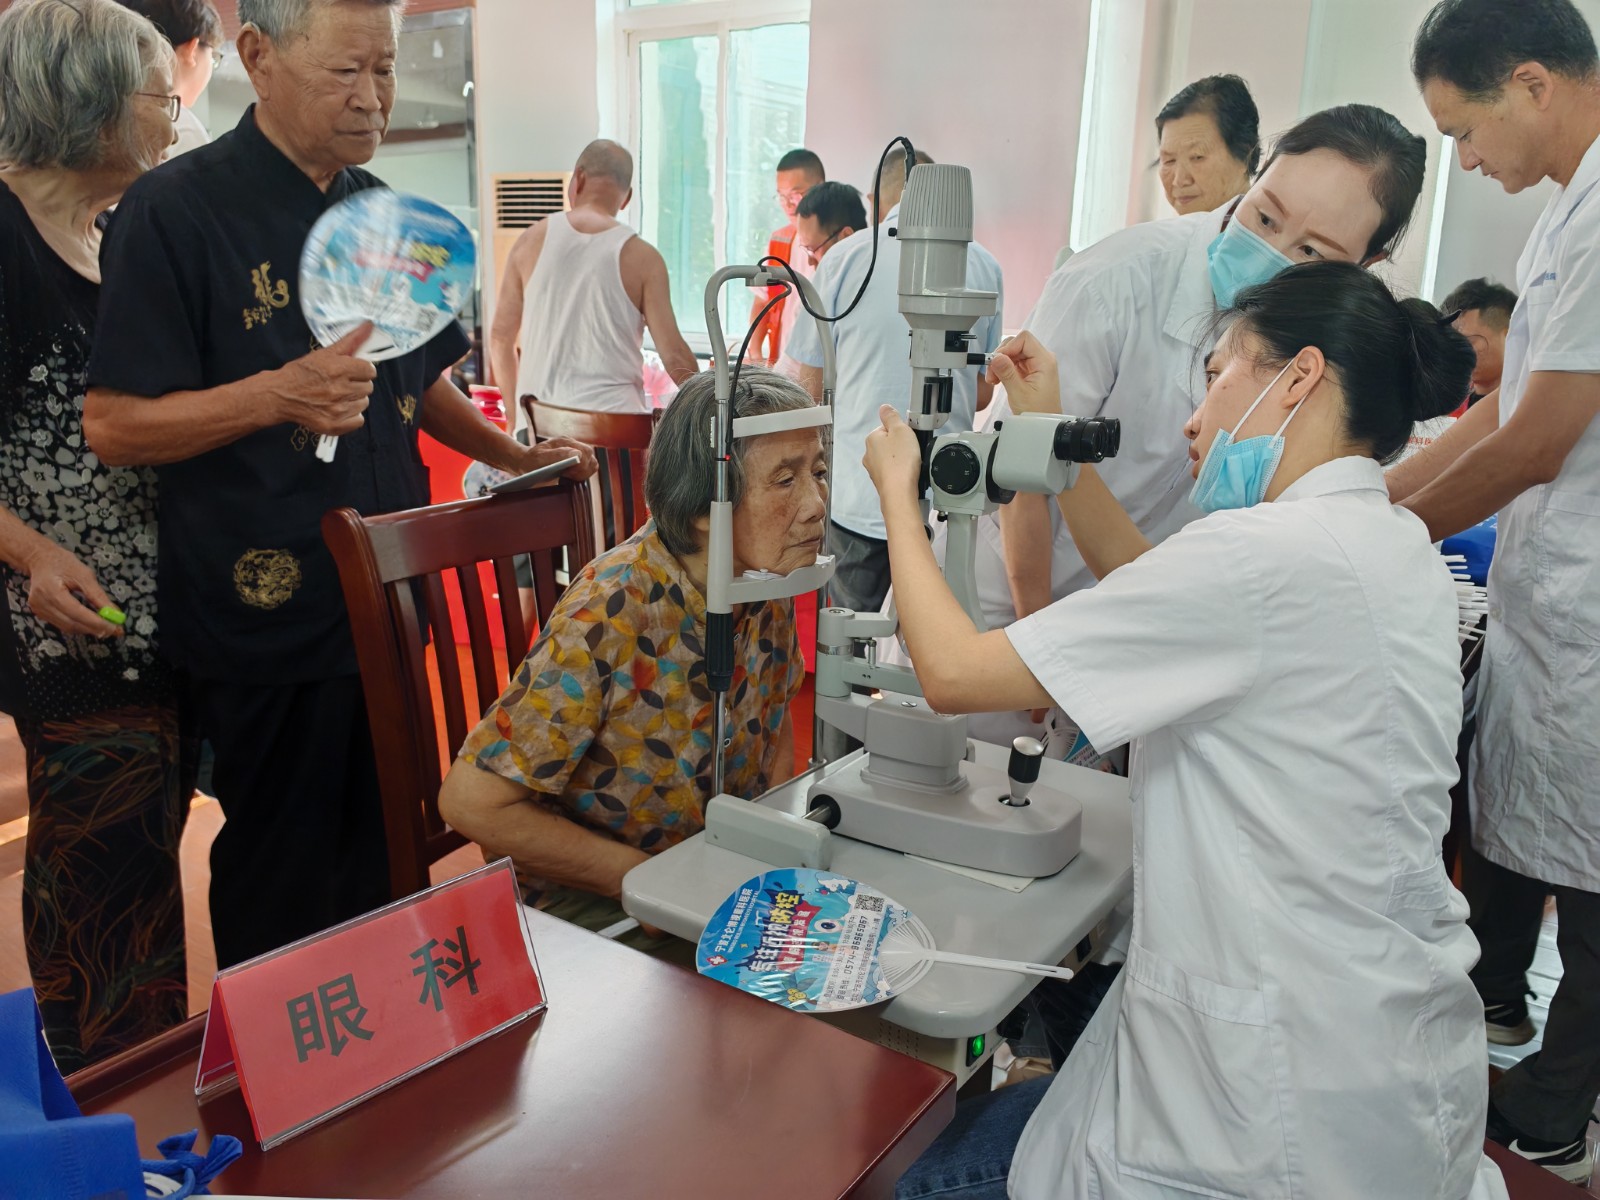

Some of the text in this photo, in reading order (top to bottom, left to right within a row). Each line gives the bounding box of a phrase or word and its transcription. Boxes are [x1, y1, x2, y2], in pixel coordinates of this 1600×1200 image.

[749, 892, 800, 971] 专注近视防控
[844, 916, 868, 974] 0574-86965067
[286, 925, 481, 1063] 眼科
